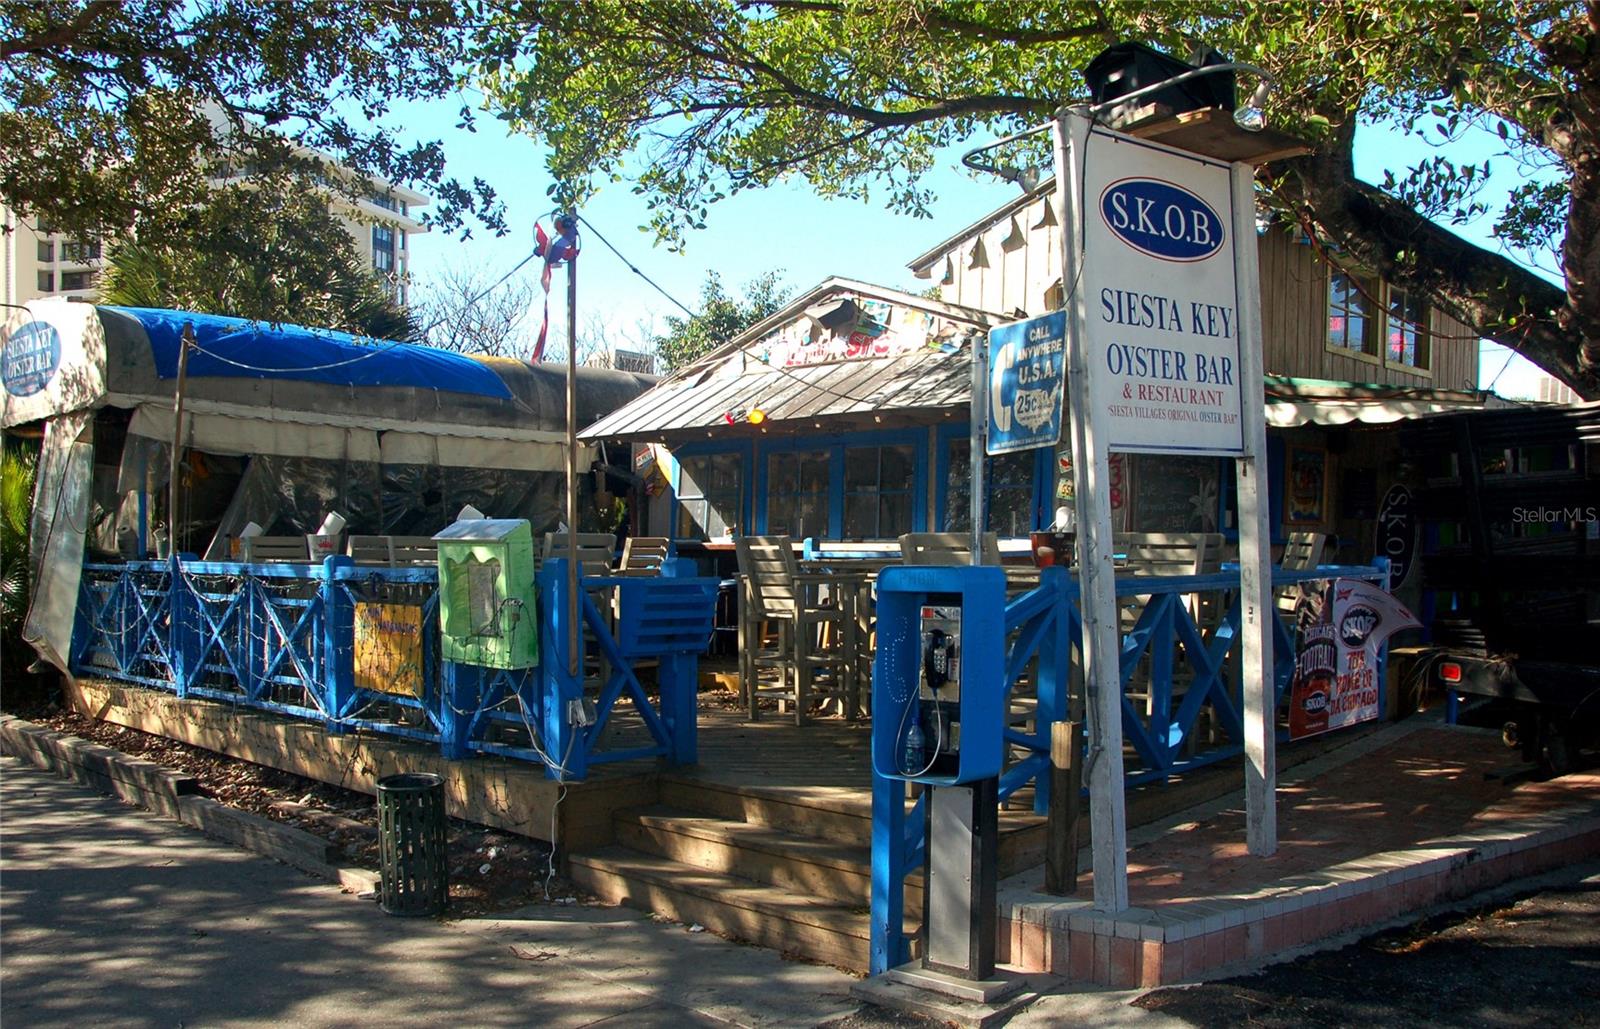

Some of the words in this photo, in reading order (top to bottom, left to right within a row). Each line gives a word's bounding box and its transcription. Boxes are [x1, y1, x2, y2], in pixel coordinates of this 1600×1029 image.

[1111, 191, 1216, 248] S.K.O.B.
[1100, 287, 1183, 332] SIESTA
[1190, 302, 1233, 339] KEY
[1029, 325, 1050, 342] CALL
[7, 334, 34, 360] SIESTA
[1016, 338, 1063, 362] ANYWHERE
[8, 356, 35, 379] OYSTER
[36, 351, 53, 371] BAR
[1018, 360, 1057, 385] U.S.A.
[1106, 343, 1188, 381] OYSTER
[1195, 353, 1233, 386] BAR
[1122, 382, 1133, 400] &
[1138, 384, 1224, 406] RESTAURANT
[1134, 406, 1167, 421] VILLAGES
[1167, 409, 1199, 423] ORIGINAL
[1199, 411, 1223, 424] OYSTER
